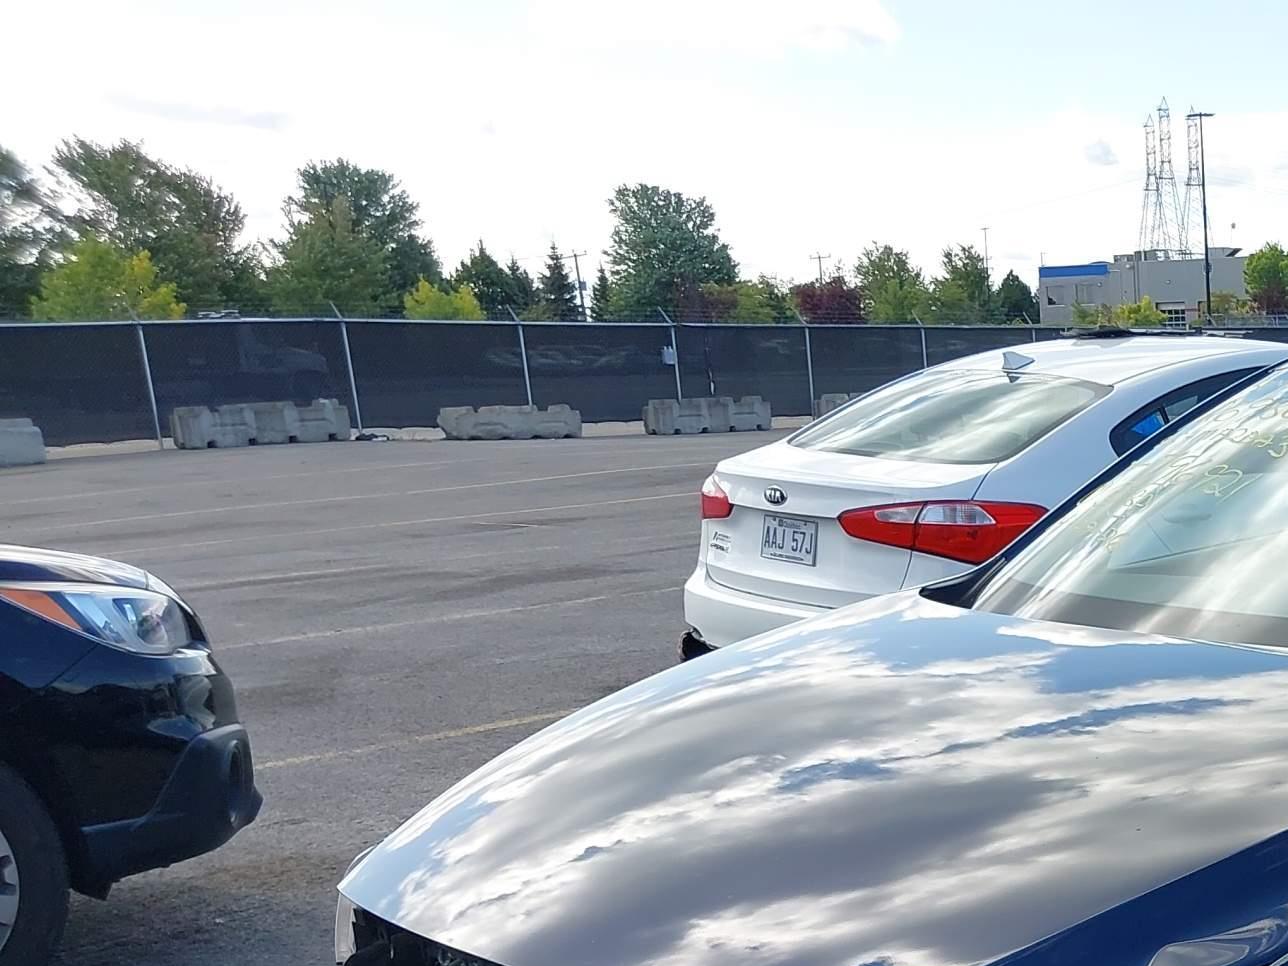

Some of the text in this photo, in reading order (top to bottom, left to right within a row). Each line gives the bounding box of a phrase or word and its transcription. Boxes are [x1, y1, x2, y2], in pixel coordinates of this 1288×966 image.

[764, 488, 783, 502] KIA
[763, 525, 814, 555] AAJ 57J
